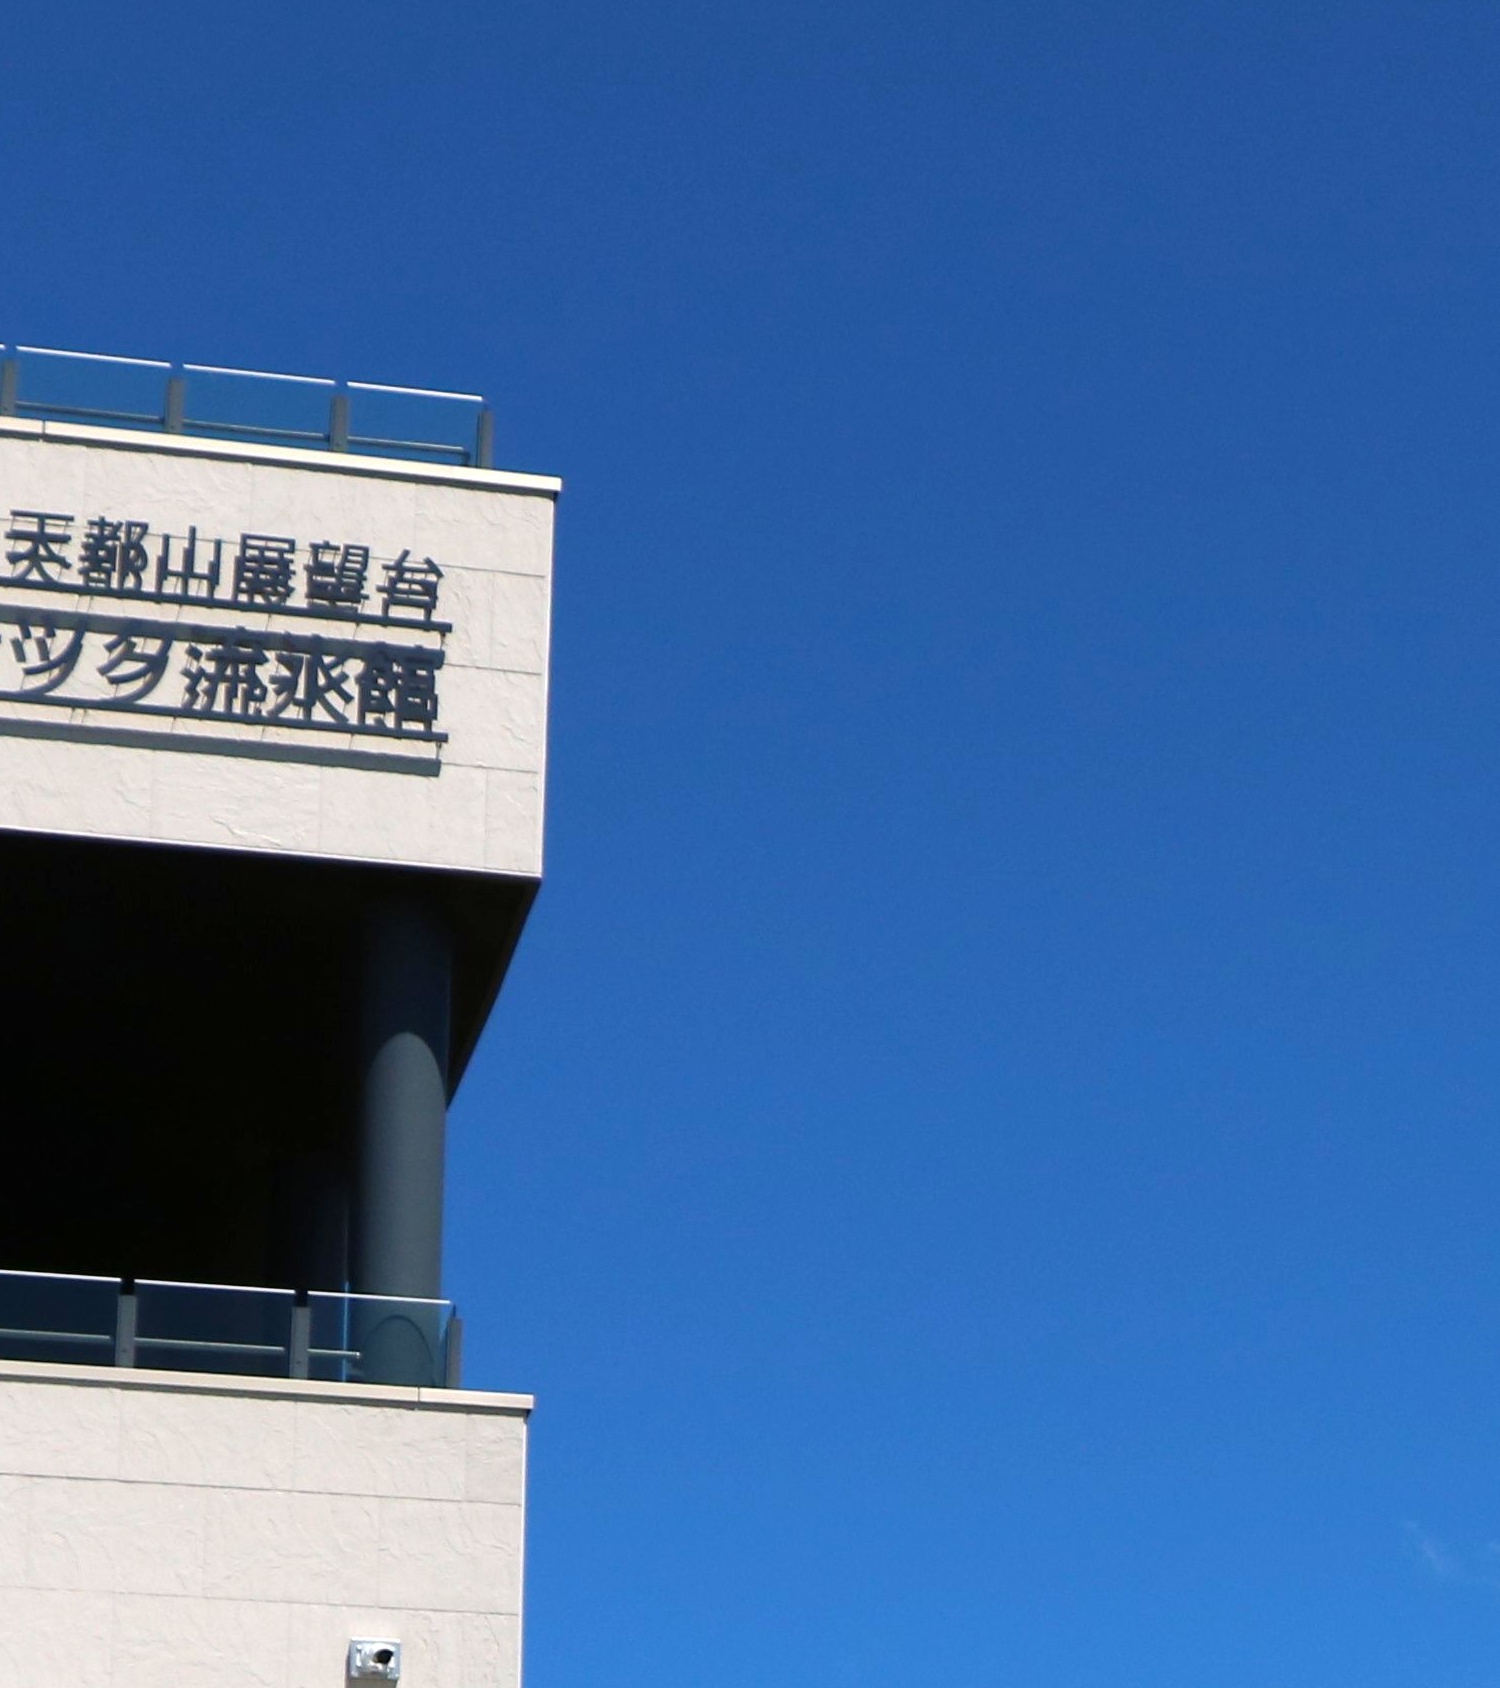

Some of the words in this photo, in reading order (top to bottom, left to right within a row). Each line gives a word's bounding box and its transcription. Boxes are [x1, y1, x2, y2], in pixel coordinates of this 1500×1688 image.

[5, 509, 445, 619] 天都山展望台
